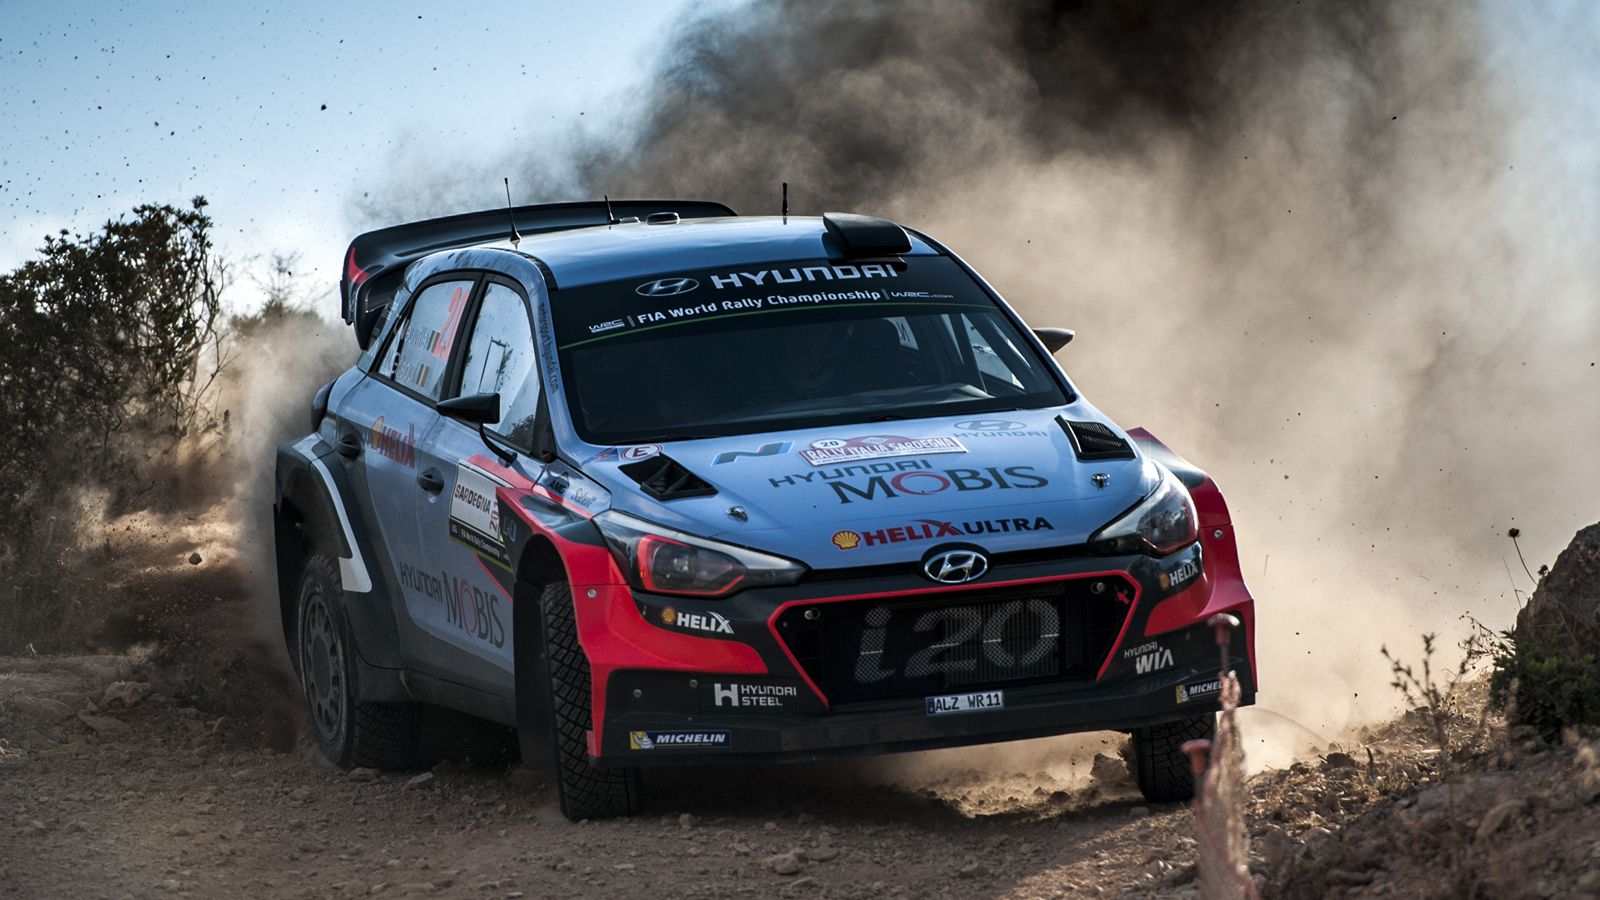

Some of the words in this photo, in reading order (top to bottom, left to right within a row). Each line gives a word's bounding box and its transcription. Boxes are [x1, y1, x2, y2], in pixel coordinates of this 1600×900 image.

[710, 263, 898, 289] HYUNDAI
[588, 318, 626, 333] WRC
[637, 311, 666, 324] FIA
[668, 302, 717, 318] World
[721, 297, 762, 310] Rally
[769, 289, 881, 306] Championship
[820, 440, 840, 448] 20
[953, 430, 1048, 438] HYUNDAI
[809, 446, 849, 460] RALLY
[850, 444, 887, 456] ITALIA
[889, 437, 955, 451] SARDEGNA
[768, 460, 932, 487] HYUNDAI
[827, 466, 1048, 504] MOBIS
[455, 484, 491, 514] SARDEGNA
[862, 519, 963, 546] HELIX
[963, 517, 1054, 535] ULTRA
[1169, 561, 1198, 587] HELIX
[400, 561, 443, 602] HYUNDAI
[442, 571, 504, 648] MOBIS
[677, 611, 734, 634] HELIX
[855, 600, 1060, 684] i20
[1124, 641, 1157, 658] HYUNDAI
[741, 685, 797, 696] HYUNDAI
[742, 696, 783, 706] STEEL
[936, 697, 960, 711] ALZ
[656, 734, 725, 743] MICHELIN
